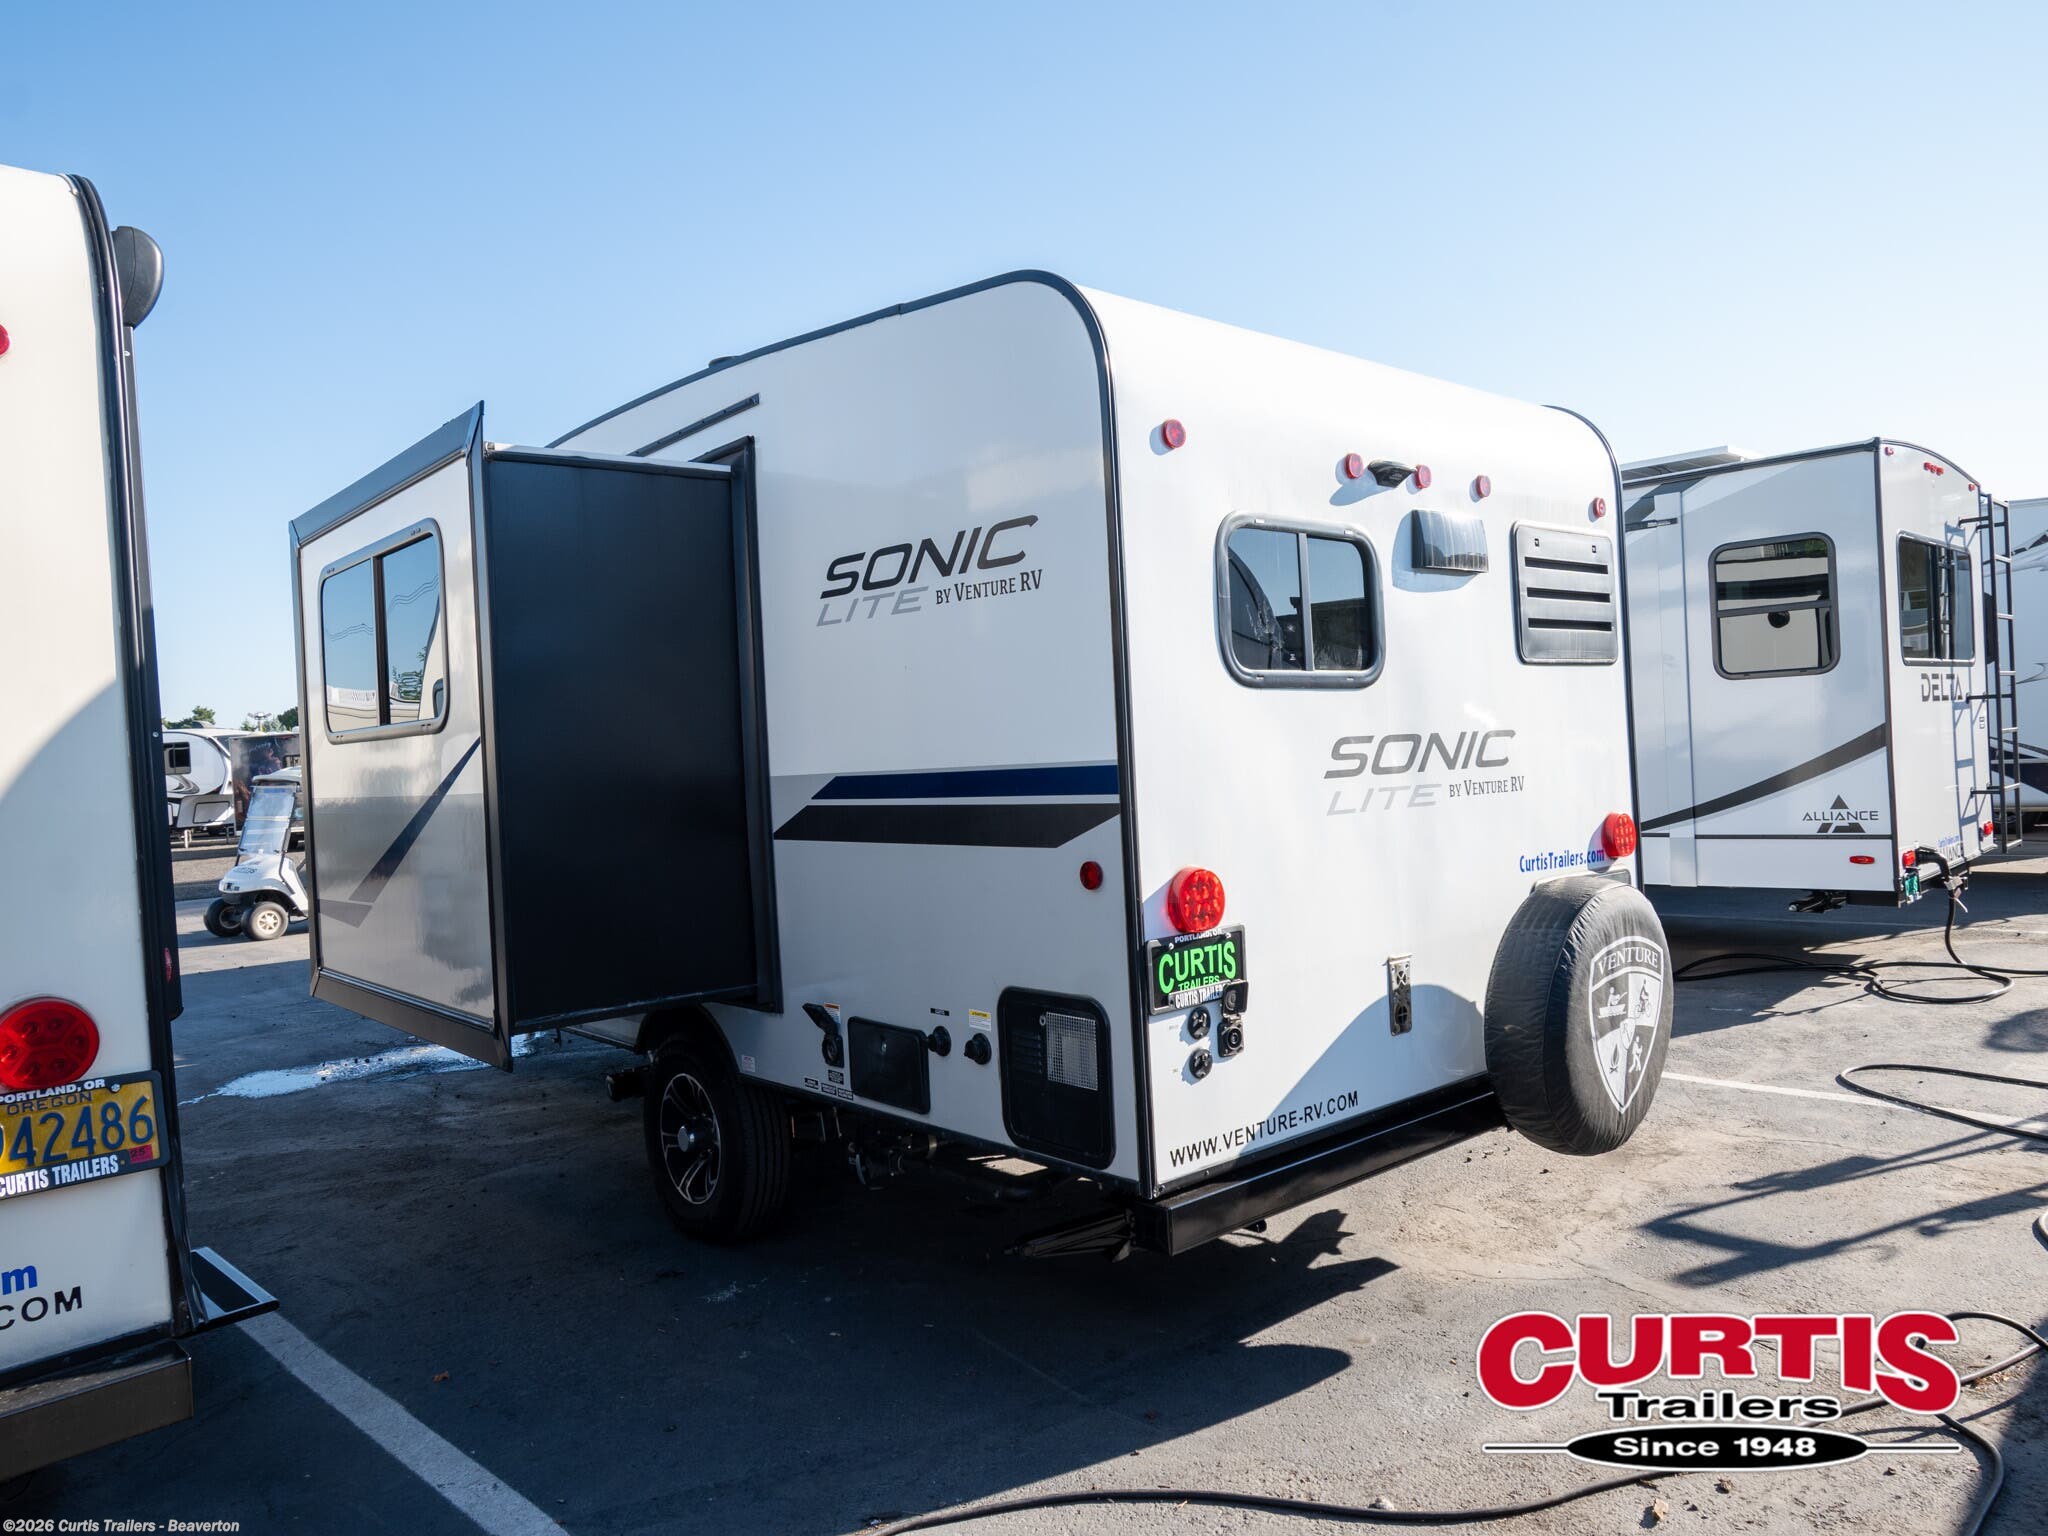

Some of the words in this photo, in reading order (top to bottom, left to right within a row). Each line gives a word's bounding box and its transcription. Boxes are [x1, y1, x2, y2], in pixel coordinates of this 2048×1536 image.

[820, 514, 1039, 599] SONIC
[1020, 568, 1043, 592] RV
[816, 586, 929, 627] LITE
[1920, 672, 1963, 702] DELTA
[1324, 728, 1516, 779] SONIC
[1511, 776, 1525, 792] RV
[1326, 783, 1442, 816] LITE
[1802, 809, 1880, 822] ALLIANCE
[1519, 848, 1605, 873] CurtisTrailers.com
[1159, 941, 1236, 994] CURTIS
[1598, 946, 1658, 976] VENTURE
[1175, 992, 1199, 1009] CURTIS
[83, 1078, 106, 1090] OR
[7, 1091, 93, 1115] OREGON
[0, 1096, 154, 1166] 42486
[1170, 1090, 1359, 1168] WWW.VENTURE-RV.COM
[52, 1154, 119, 1185] TRAILERS
